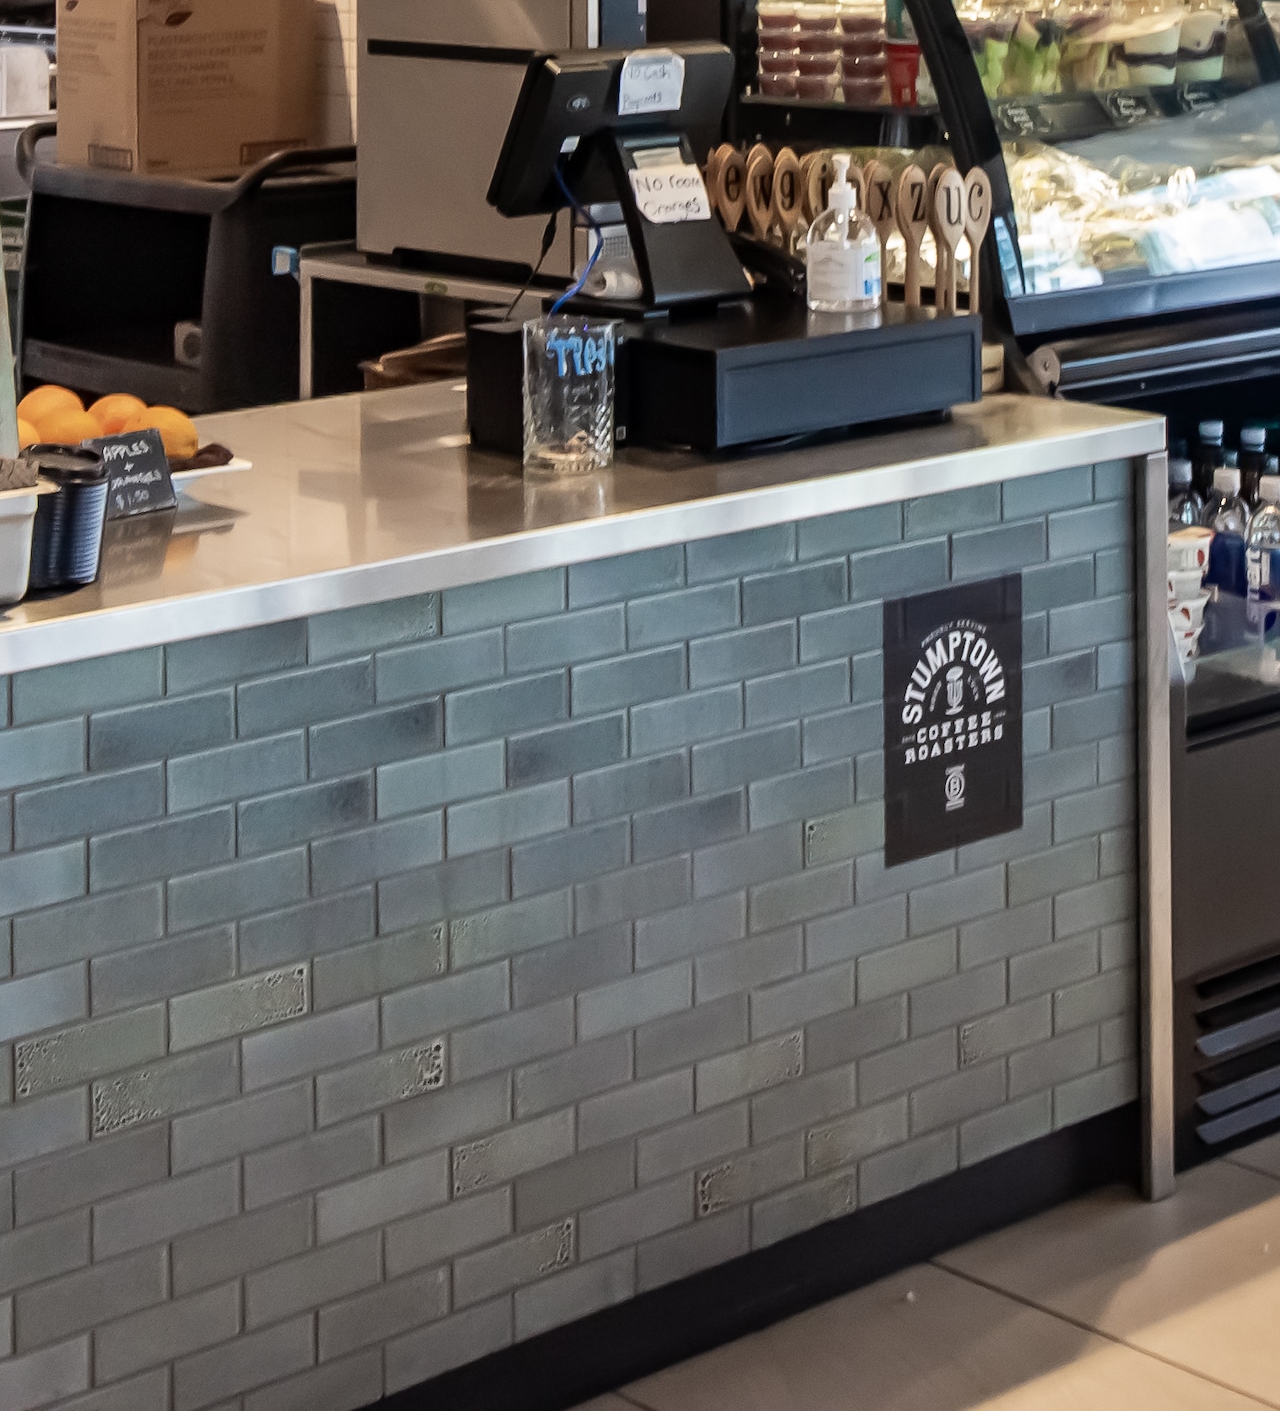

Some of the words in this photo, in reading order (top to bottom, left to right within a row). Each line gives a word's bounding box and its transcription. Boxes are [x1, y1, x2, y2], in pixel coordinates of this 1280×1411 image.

[781, 170, 795, 211] g
[873, 180, 893, 222] x
[910, 182, 926, 223] z
[943, 185, 963, 226] u
[967, 181, 984, 222] c
[902, 630, 1006, 725] STUMPTOWN
[904, 723, 1004, 765] ROASTERS
[917, 710, 992, 745] COFFEE
